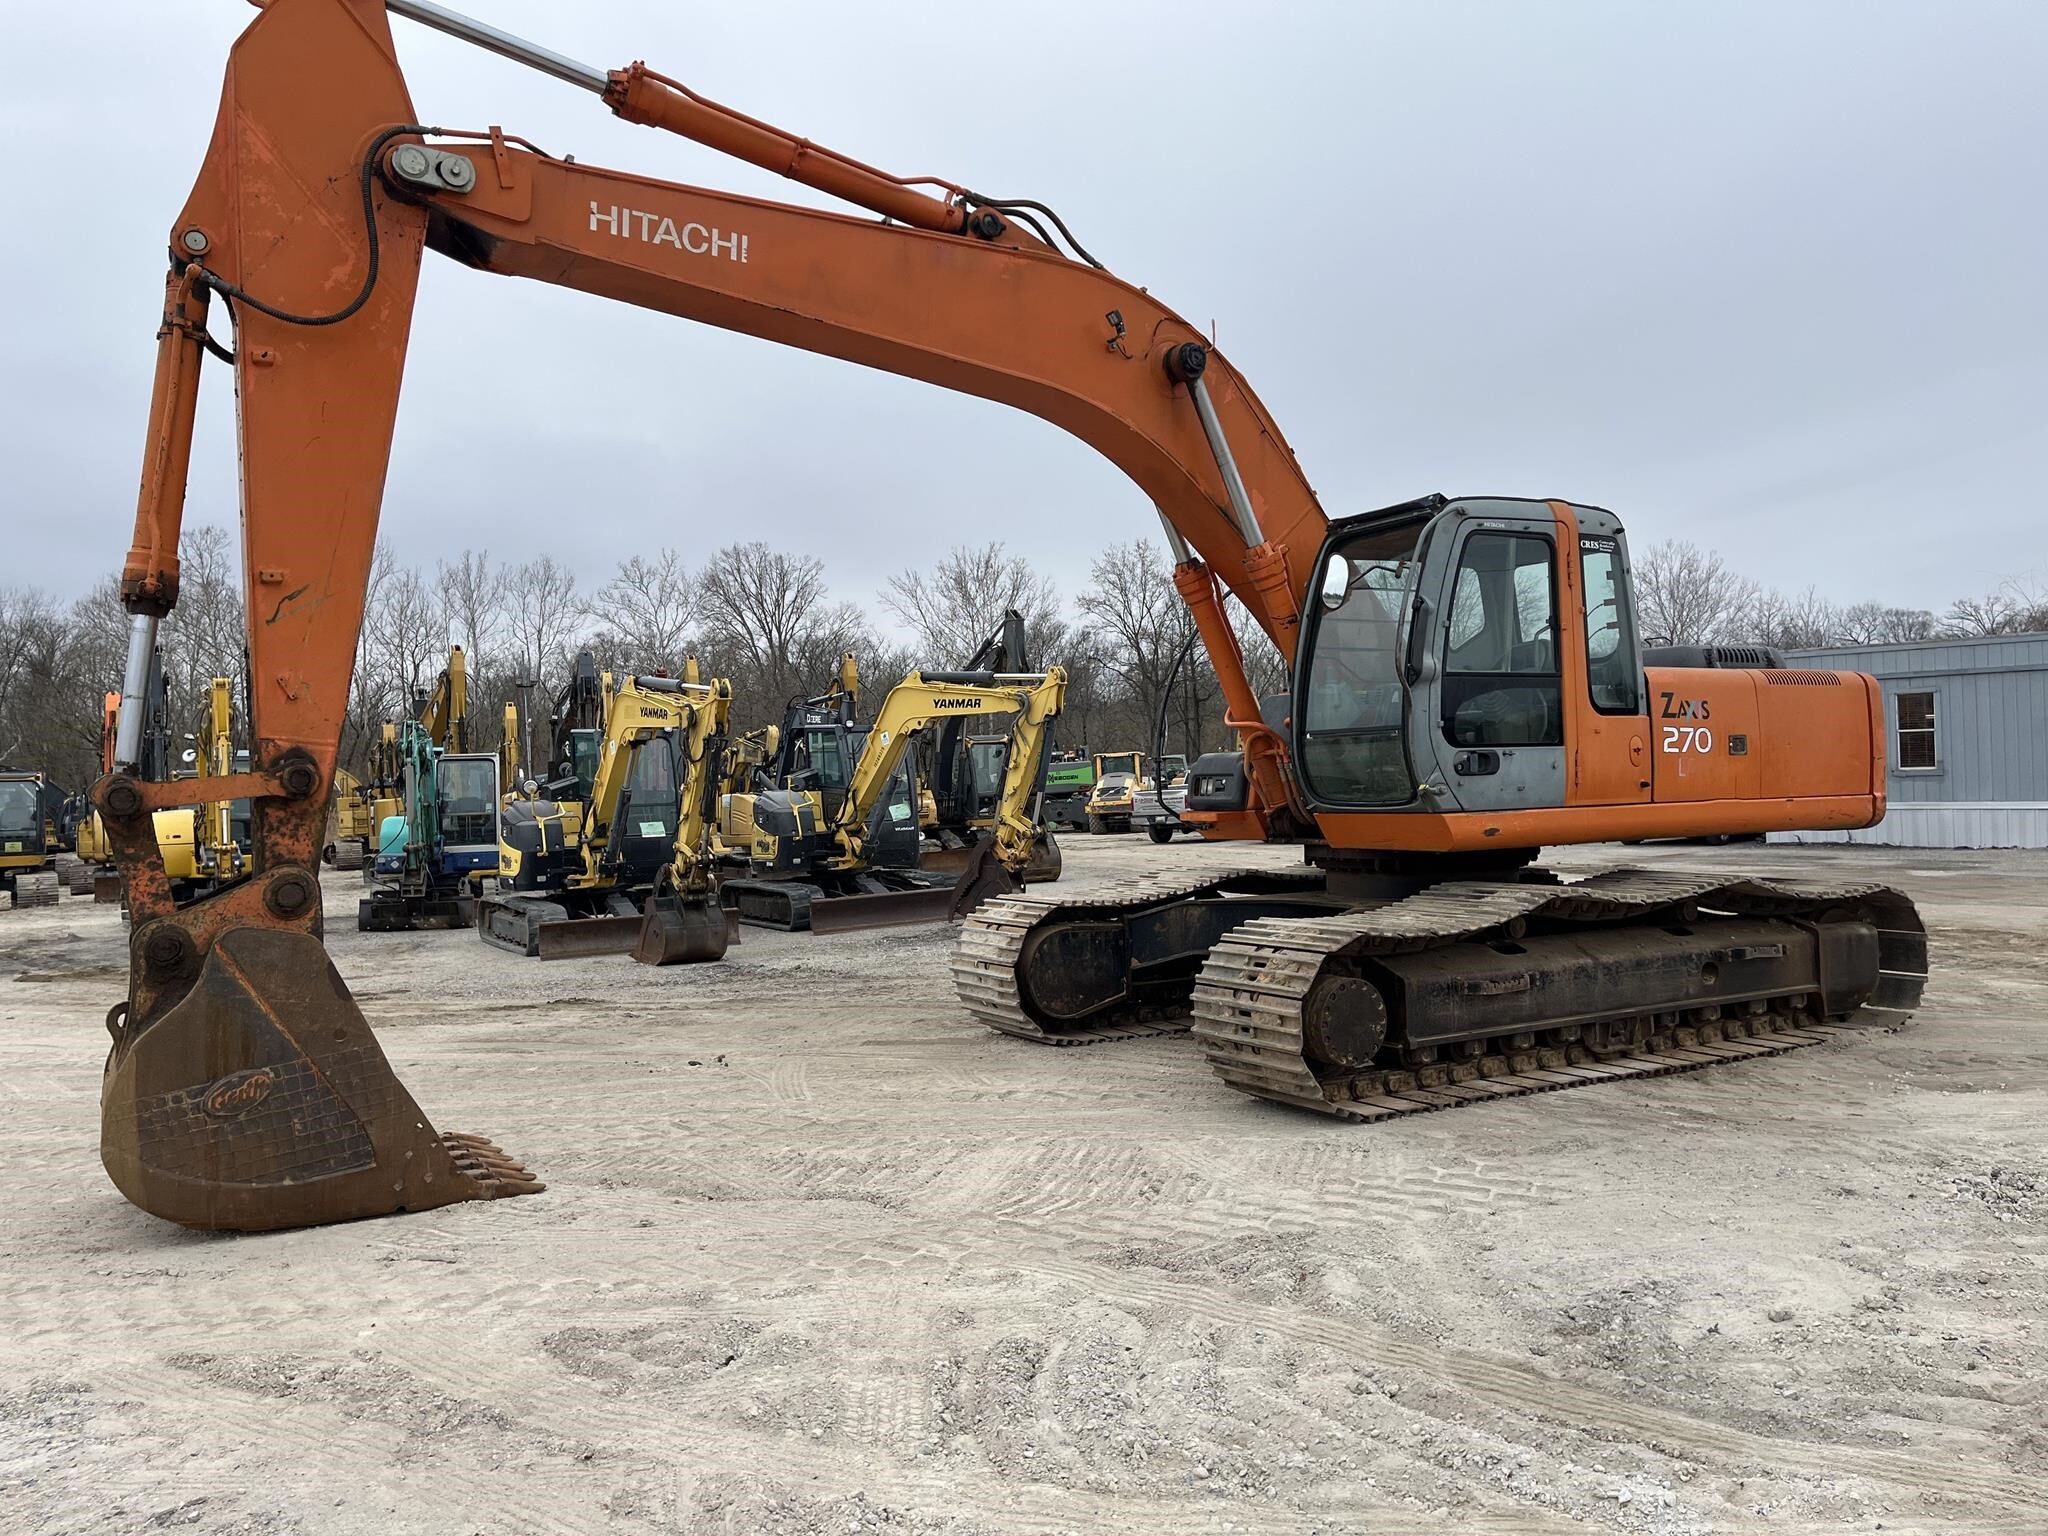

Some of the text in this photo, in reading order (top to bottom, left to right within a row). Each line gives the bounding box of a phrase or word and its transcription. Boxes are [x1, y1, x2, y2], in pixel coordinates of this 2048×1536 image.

[590, 201, 748, 263] HITACHI
[1580, 540, 1599, 550] CRES
[933, 699, 981, 708] YANMAR
[639, 706, 668, 720] YANMAR
[1663, 727, 1712, 753] 270
